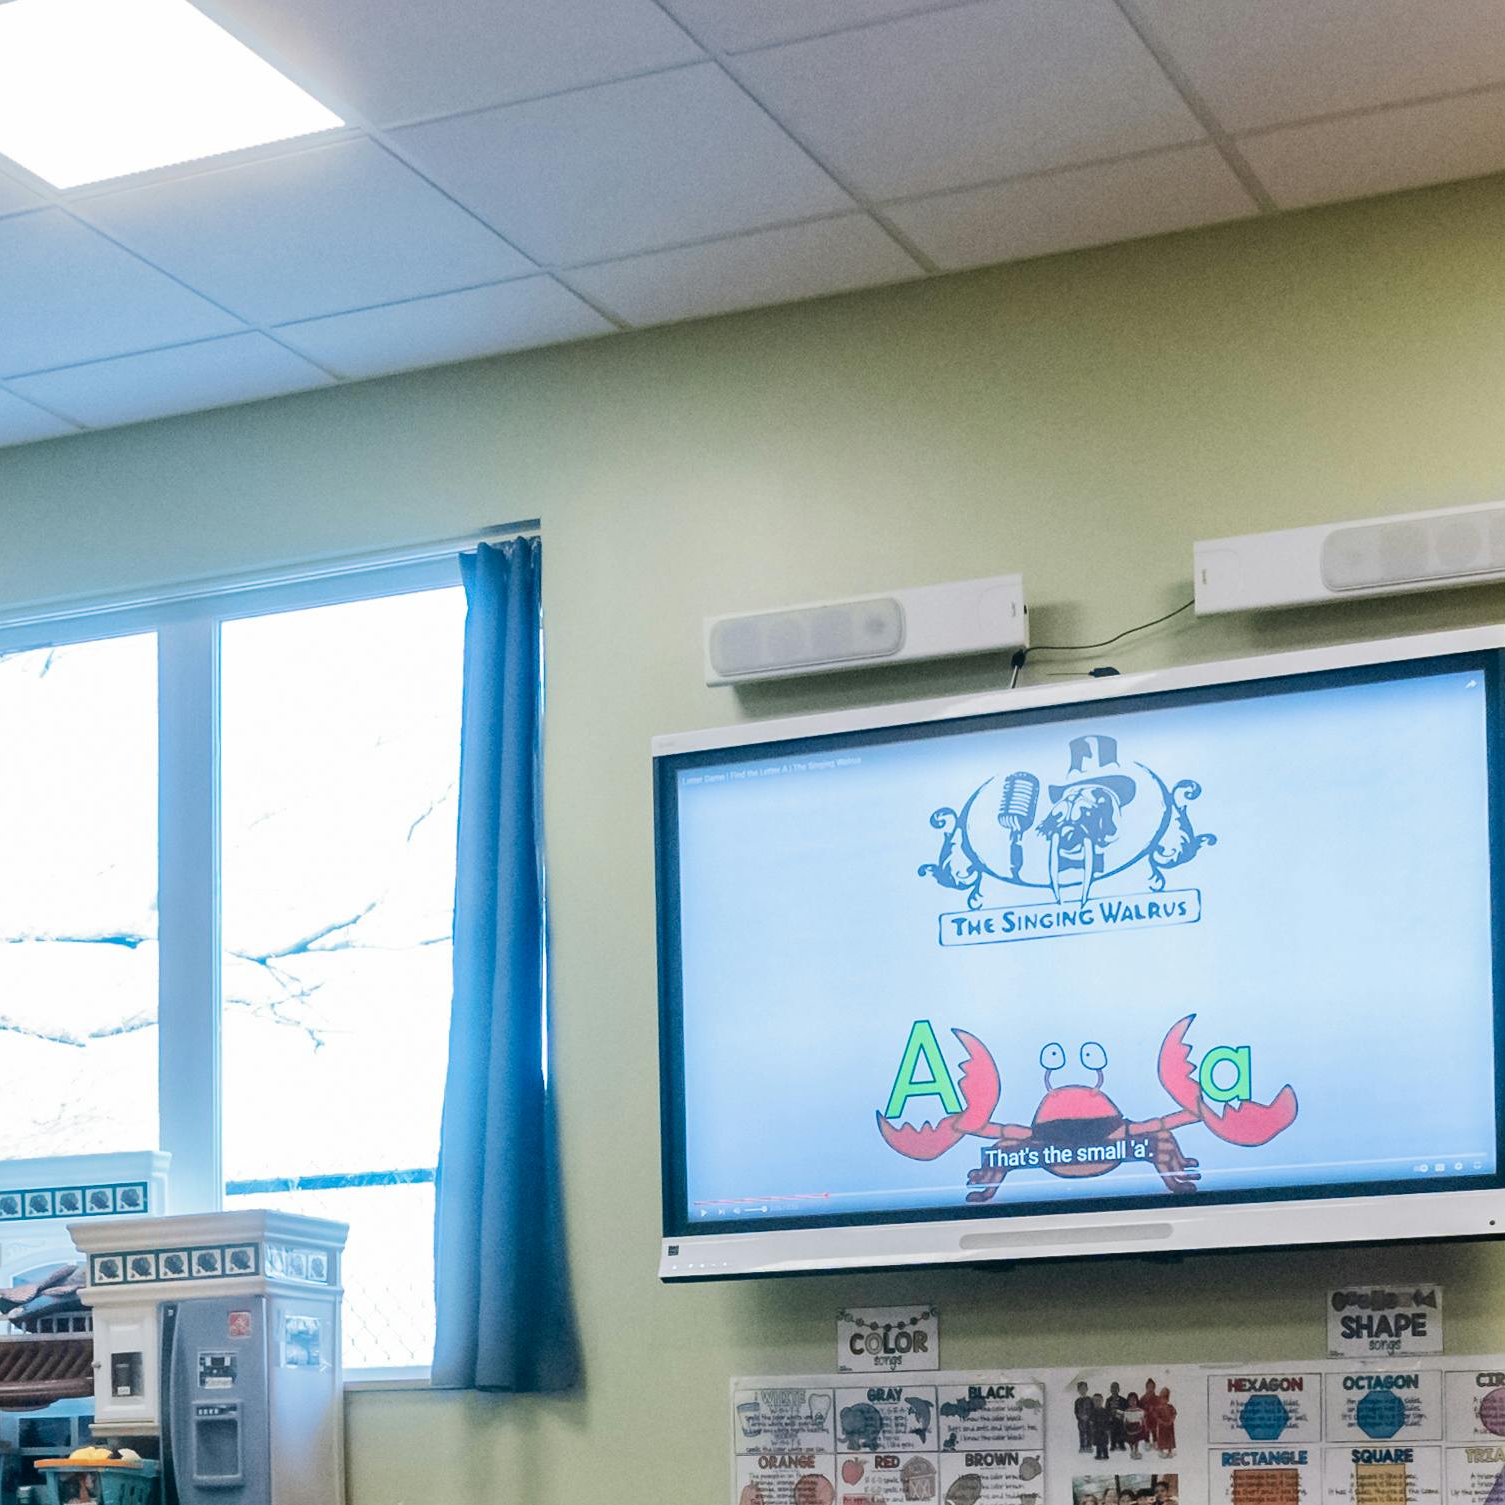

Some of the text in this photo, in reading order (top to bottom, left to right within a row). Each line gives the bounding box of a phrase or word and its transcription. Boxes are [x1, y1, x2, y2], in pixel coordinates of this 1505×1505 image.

[1002, 909, 1094, 933] SINGING
[1099, 901, 1187, 925] WALRUS
[885, 1019, 1252, 1119] A a
[985, 1148, 1039, 1167] That's
[1043, 1146, 1072, 1164] the
[1077, 1140, 1126, 1162] small
[1341, 1313, 1427, 1339] SHAPE
[850, 1330, 928, 1355] COLOR
[1369, 1339, 1401, 1356] songs
[1228, 1377, 1304, 1392] HEXAGON
[1343, 1374, 1419, 1390] OCTAGON
[867, 1387, 903, 1402] GRAY
[968, 1386, 1015, 1400] BLACK
[758, 1455, 815, 1470] ORANGE
[875, 1455, 900, 1469] RED
[965, 1452, 1019, 1467] BROWN
[1222, 1450, 1308, 1467] RECTANGLE
[1351, 1448, 1414, 1464] SQUARE
